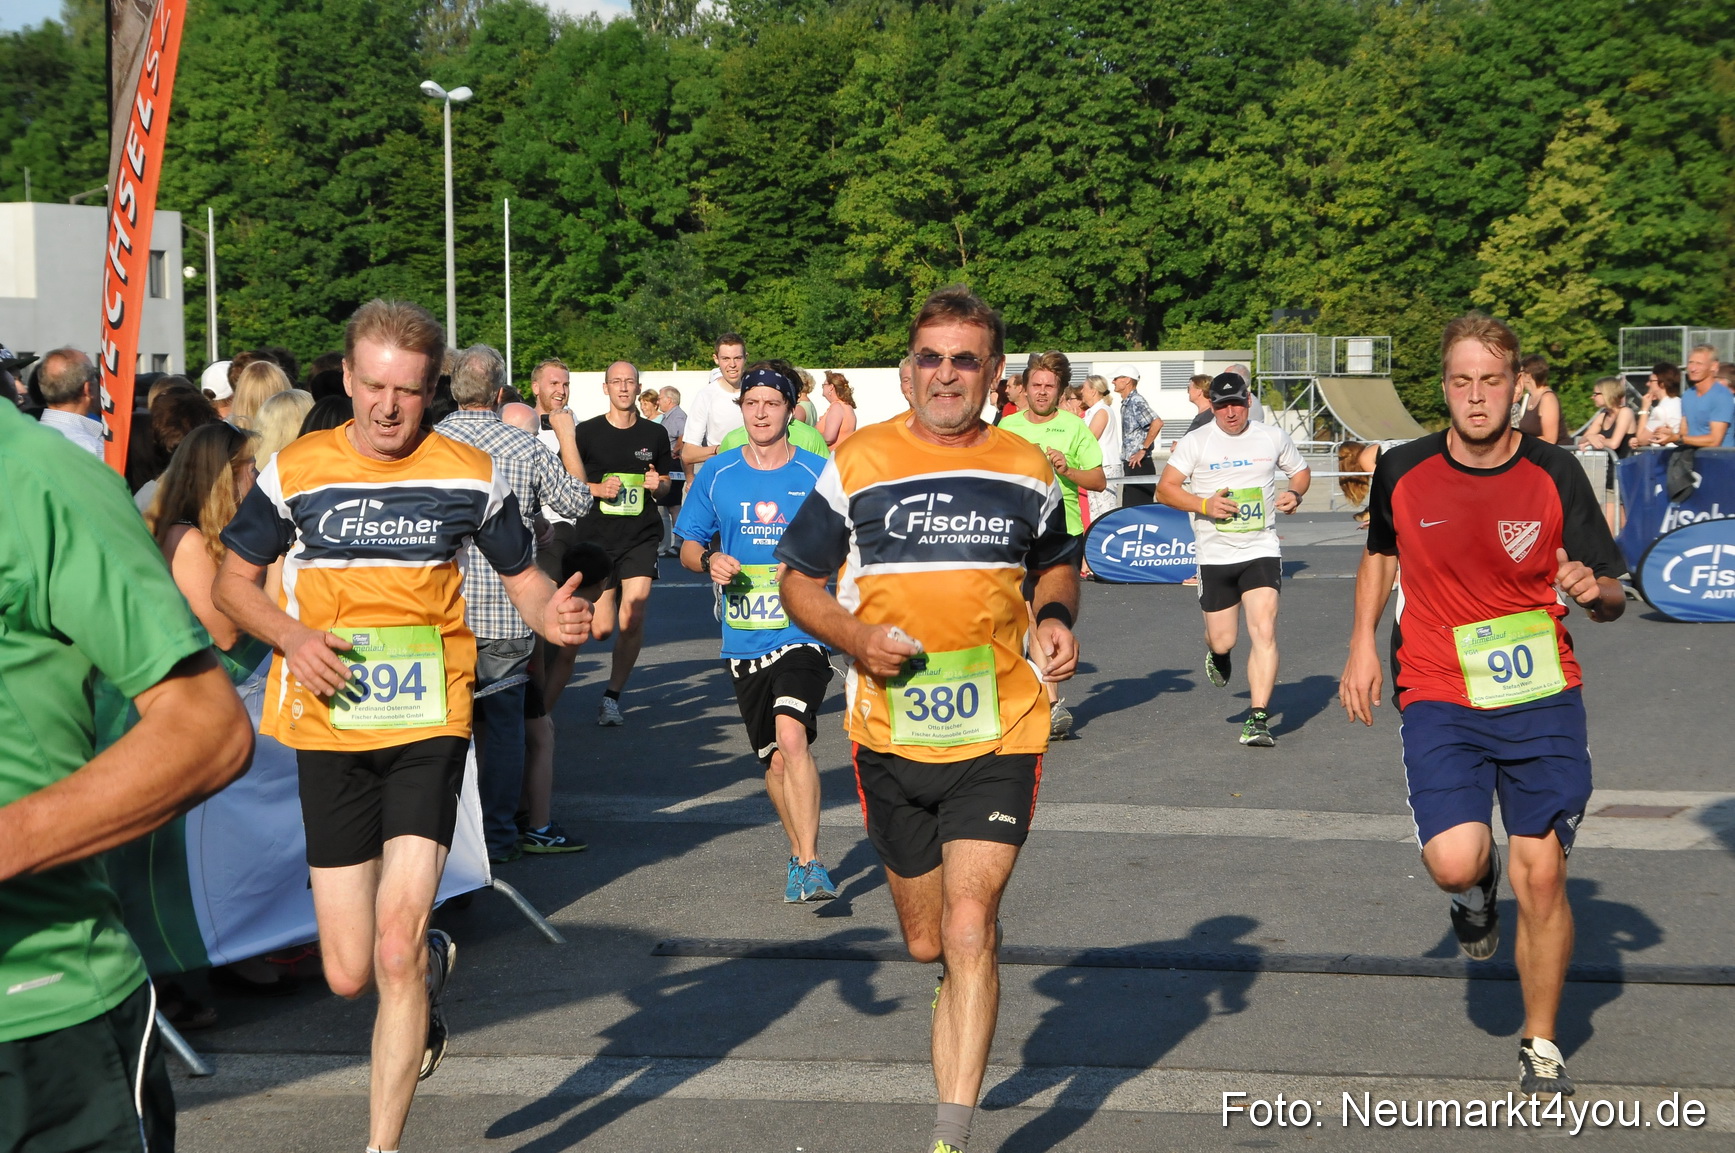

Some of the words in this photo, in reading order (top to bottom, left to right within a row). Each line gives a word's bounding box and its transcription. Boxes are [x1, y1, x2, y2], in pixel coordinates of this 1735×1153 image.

[740, 502, 751, 523] I
[340, 516, 443, 537] Fischer
[907, 511, 1015, 533] Fischer
[741, 524, 787, 539] campin
[350, 535, 437, 546] AUTOMOBILE
[918, 534, 1010, 545] AUTOMOBILE
[1121, 538, 1196, 558] Fische
[1129, 557, 1197, 567] AUTOMOBIL
[1701, 589, 1735, 600] AUT
[729, 594, 785, 620] 5042
[1472, 631, 1507, 645] firmenlauf
[1488, 644, 1534, 684] 90
[346, 662, 427, 704] 394
[1502, 683, 1520, 691] Stefan
[386, 704, 421, 712] Ostermann
[903, 682, 979, 723] 380
[932, 730, 961, 739] Automobile
[962, 728, 980, 736] GmbH
[941, 723, 963, 731] Fischer
[998, 813, 1017, 825] asics
